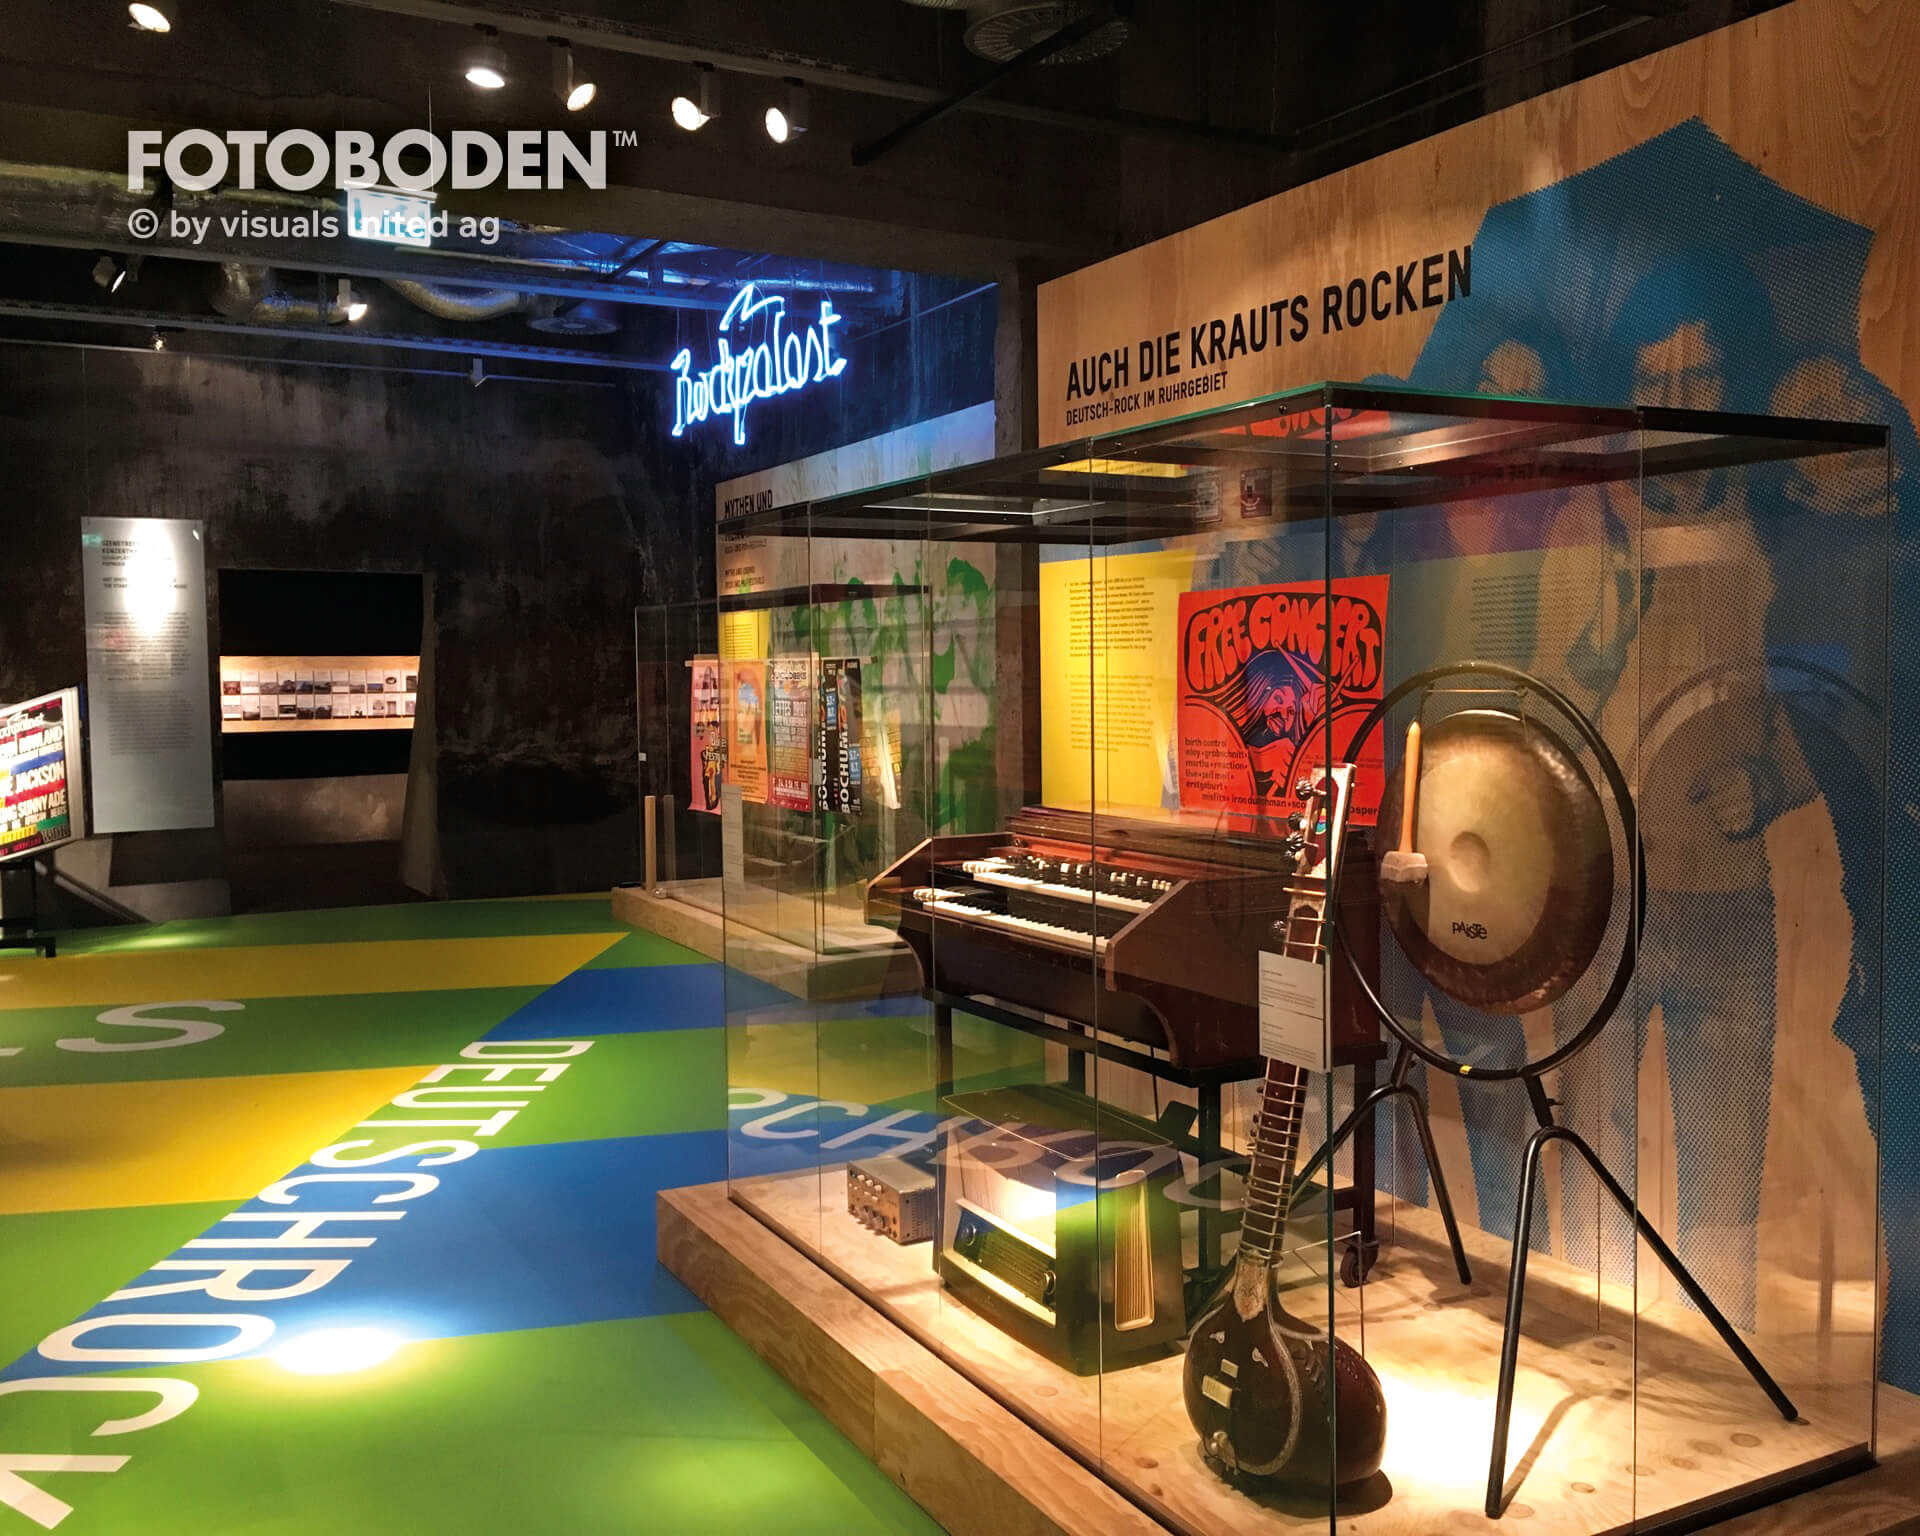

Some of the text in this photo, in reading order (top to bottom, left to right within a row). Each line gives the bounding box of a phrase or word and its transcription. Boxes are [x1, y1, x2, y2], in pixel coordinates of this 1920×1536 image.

[1066, 245, 1472, 401] AUCH DIE KRAUTS ROCKEN
[1066, 371, 1228, 426] DEUTSCH-ROCK IM RUHRGEBIET
[724, 489, 773, 519] MYTHEN UND
[1187, 600, 1252, 689] FREE
[1249, 595, 1380, 688] CONCERT
[838, 730, 851, 814] BOCHUM
[0, 999, 246, 1056] S
